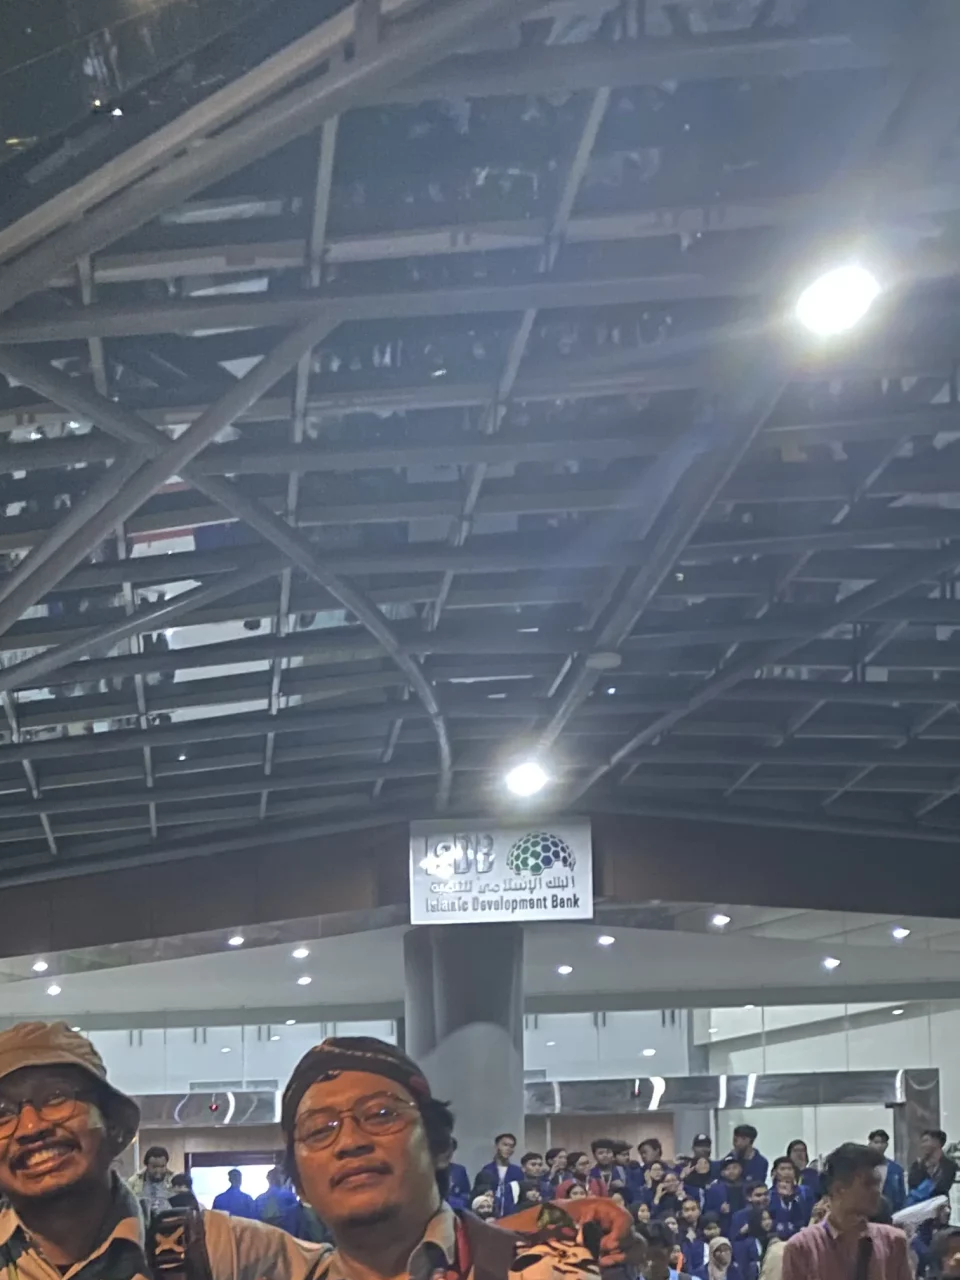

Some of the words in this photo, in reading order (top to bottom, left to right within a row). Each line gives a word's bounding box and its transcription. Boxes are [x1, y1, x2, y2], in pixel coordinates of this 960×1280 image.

[425, 895, 469, 913] Islamic
[472, 896, 548, 913] Development
[551, 894, 580, 909] Bank
